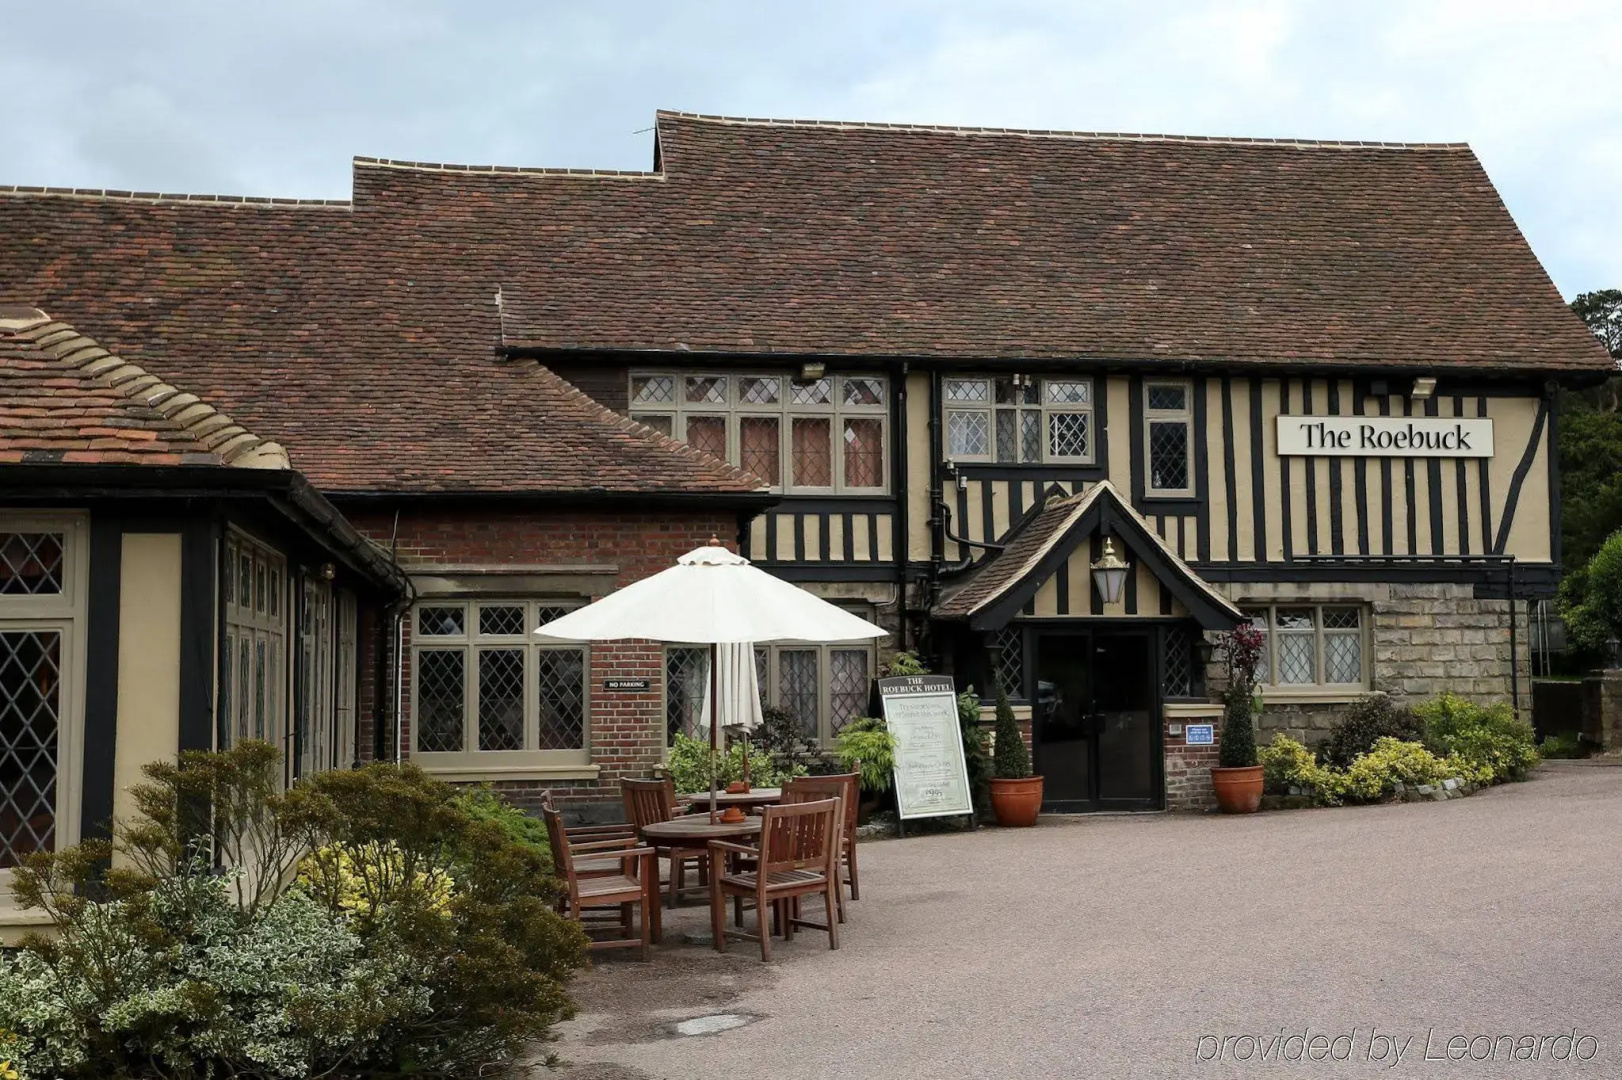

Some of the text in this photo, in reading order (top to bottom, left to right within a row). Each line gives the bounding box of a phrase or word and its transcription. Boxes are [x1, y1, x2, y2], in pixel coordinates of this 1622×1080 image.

[1300, 423, 1472, 450] The Roebuck
[906, 677, 924, 685] THE
[882, 684, 952, 694] ROEBUCK HOTEL
